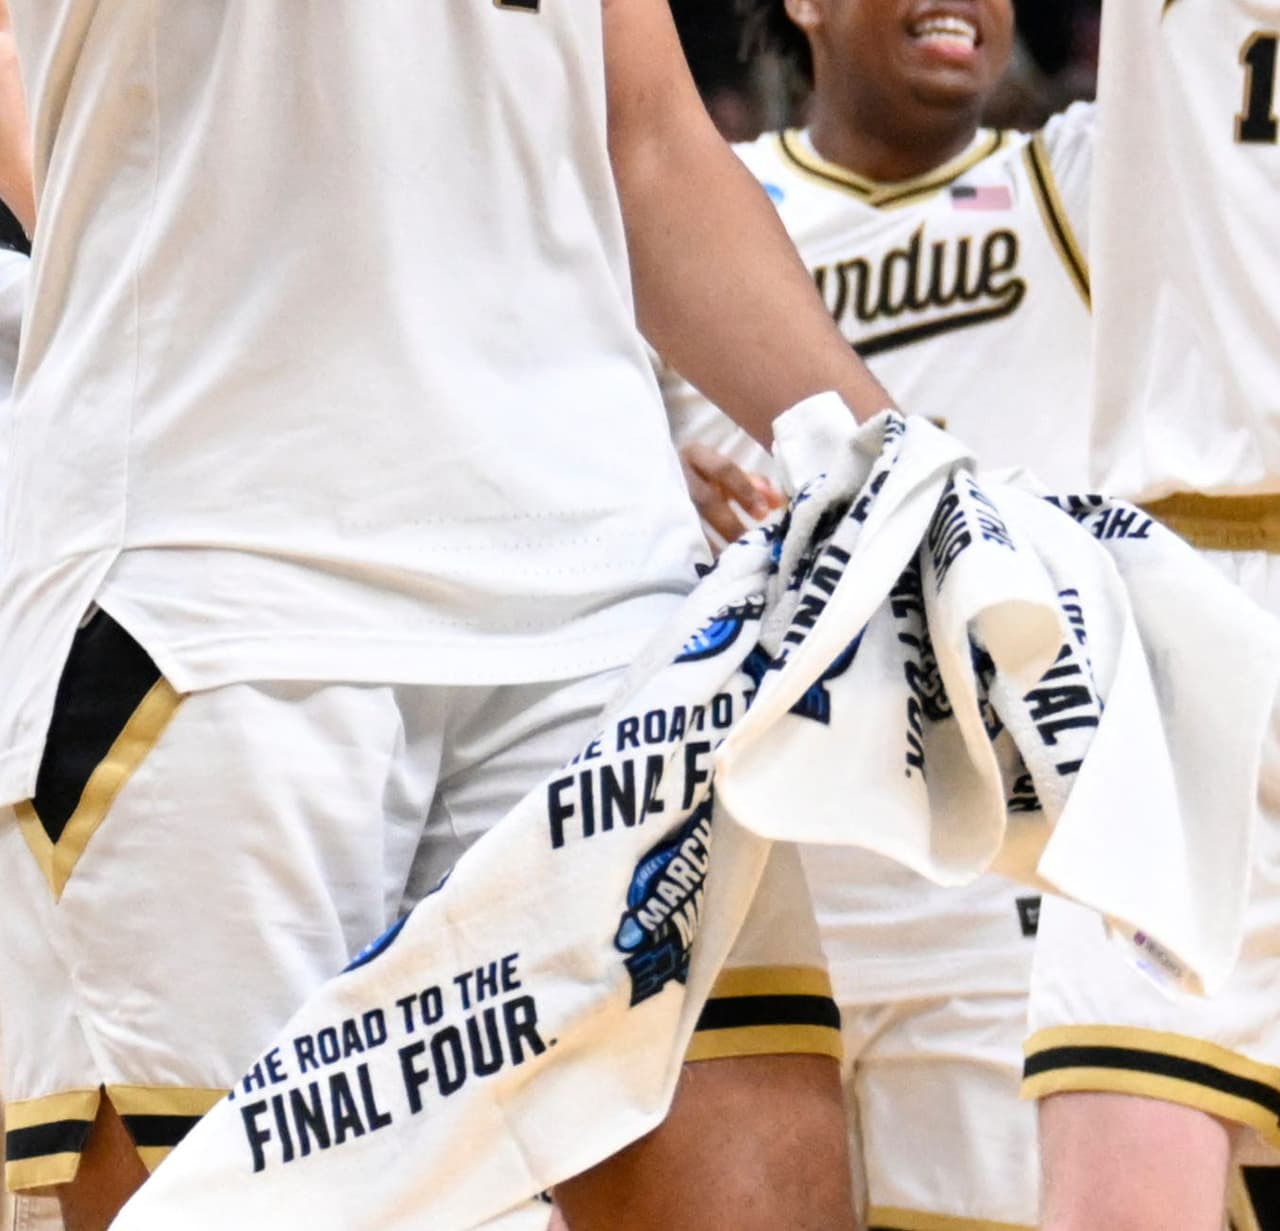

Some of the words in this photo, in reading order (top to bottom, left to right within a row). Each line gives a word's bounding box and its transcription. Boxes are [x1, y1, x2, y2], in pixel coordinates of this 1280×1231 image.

[294, 1008, 389, 1074] ROAD
[396, 985, 444, 1034] TO
[453, 953, 522, 1010] THE
[240, 1063, 393, 1173] FINAL
